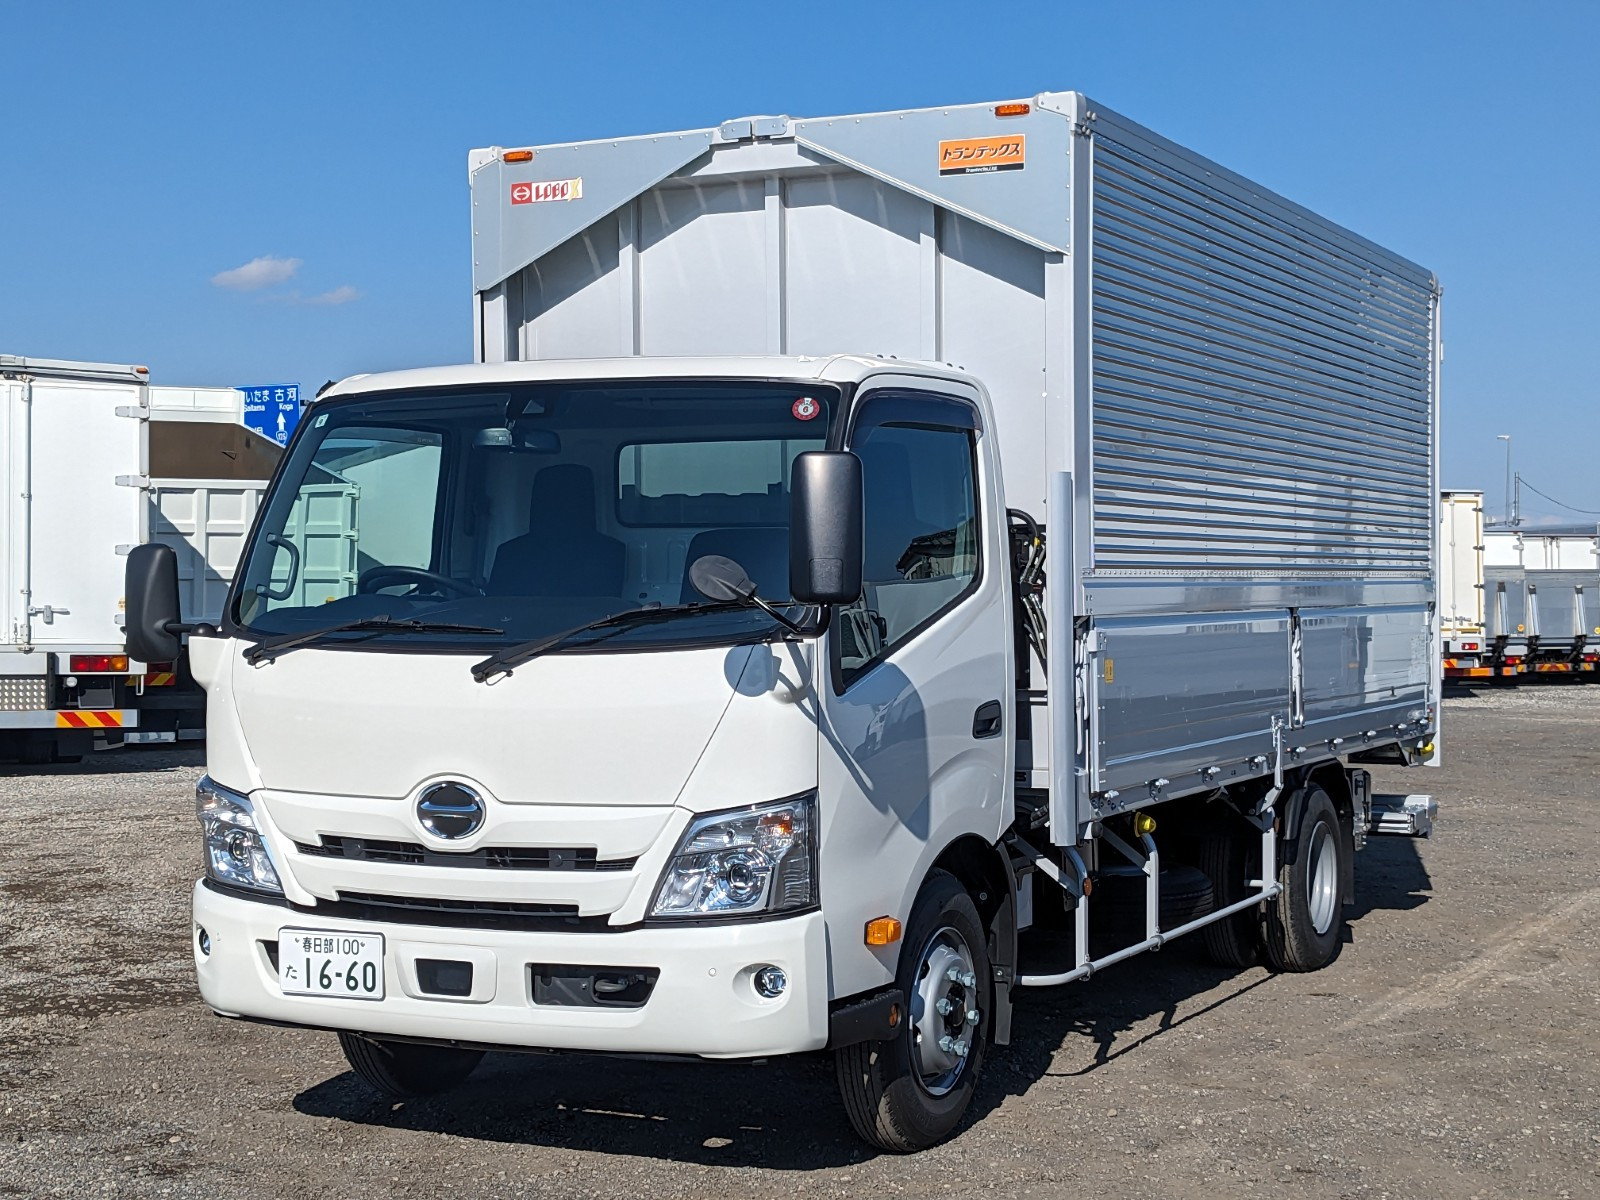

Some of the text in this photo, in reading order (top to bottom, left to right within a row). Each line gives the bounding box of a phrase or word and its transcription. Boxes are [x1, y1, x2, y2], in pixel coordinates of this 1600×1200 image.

[943, 143, 1021, 162] トランテックス
[535, 177, 582, 202] LOBOX
[274, 387, 297, 402] 古河
[279, 403, 294, 411] Koga
[285, 957, 377, 993] た 16-60
